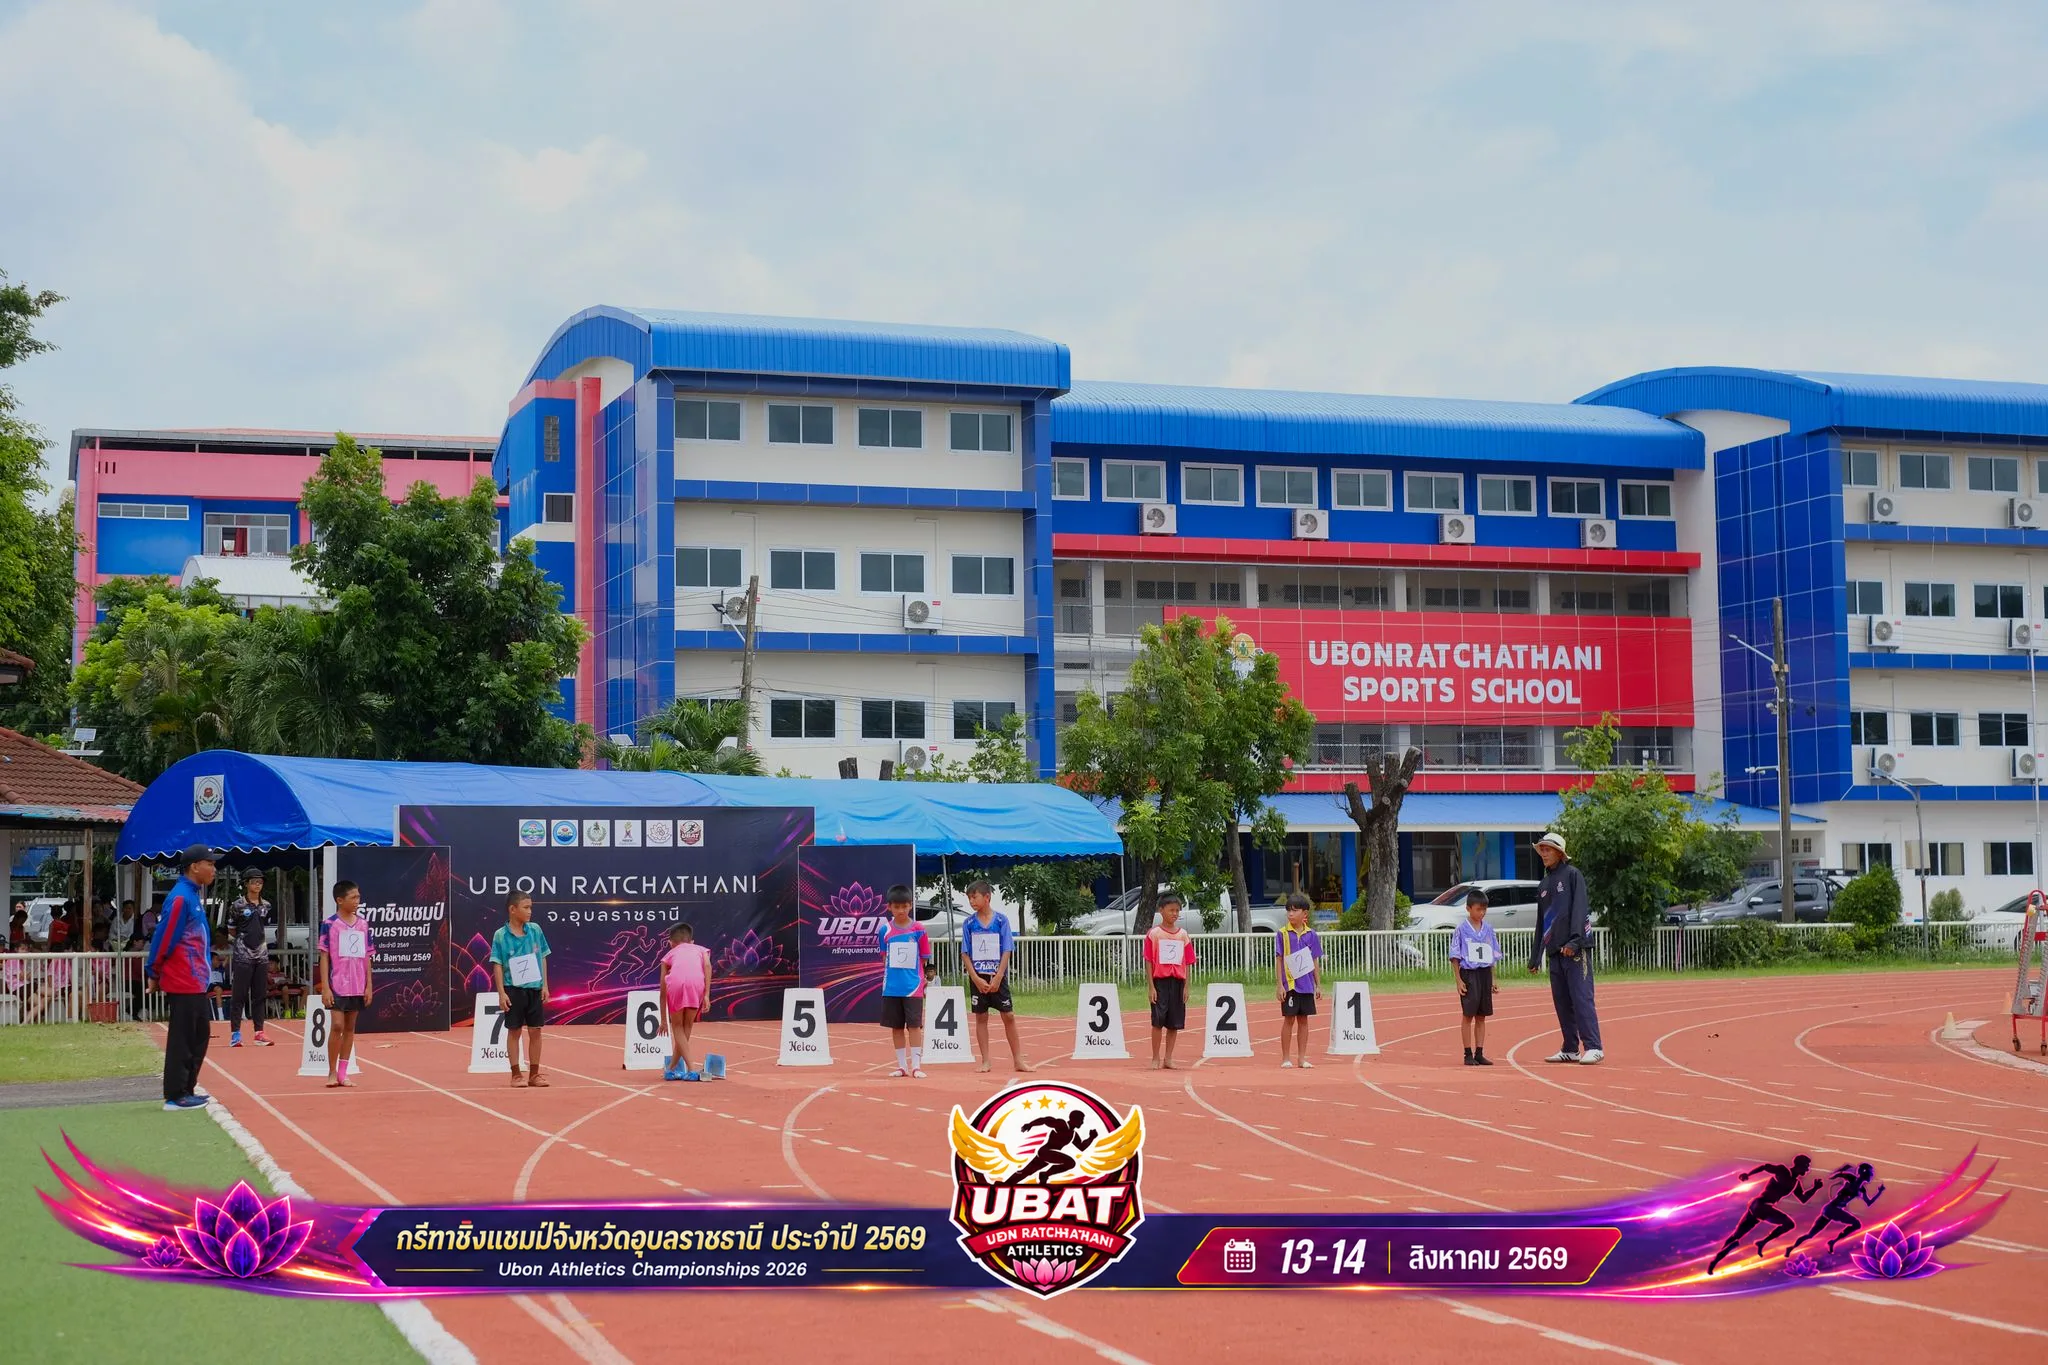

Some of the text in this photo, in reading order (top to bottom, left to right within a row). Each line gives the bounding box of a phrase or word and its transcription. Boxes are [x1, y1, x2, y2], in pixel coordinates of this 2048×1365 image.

[1308, 640, 1602, 671] UBONRATCHATHANI
[1344, 676, 1581, 704] SPORTS SCHOOL
[469, 874, 758, 895] UBON RATCHATHANI
[349, 933, 360, 954] 8
[412, 952, 432, 962] 2569
[897, 947, 909, 964] 5
[979, 939, 989, 954] 4
[1166, 944, 1178, 960] 3
[1475, 946, 1483, 960] 1
[517, 959, 529, 979] 7
[1294, 953, 1309, 972] 2
[636, 1001, 660, 1040] 6
[792, 1000, 816, 1039] 5
[934, 998, 958, 1037] 4
[1088, 995, 1110, 1033] 3
[1215, 995, 1238, 1031] 2
[1347, 992, 1362, 1029] 1
[311, 1008, 326, 1048] 8
[484, 1005, 506, 1045] 7
